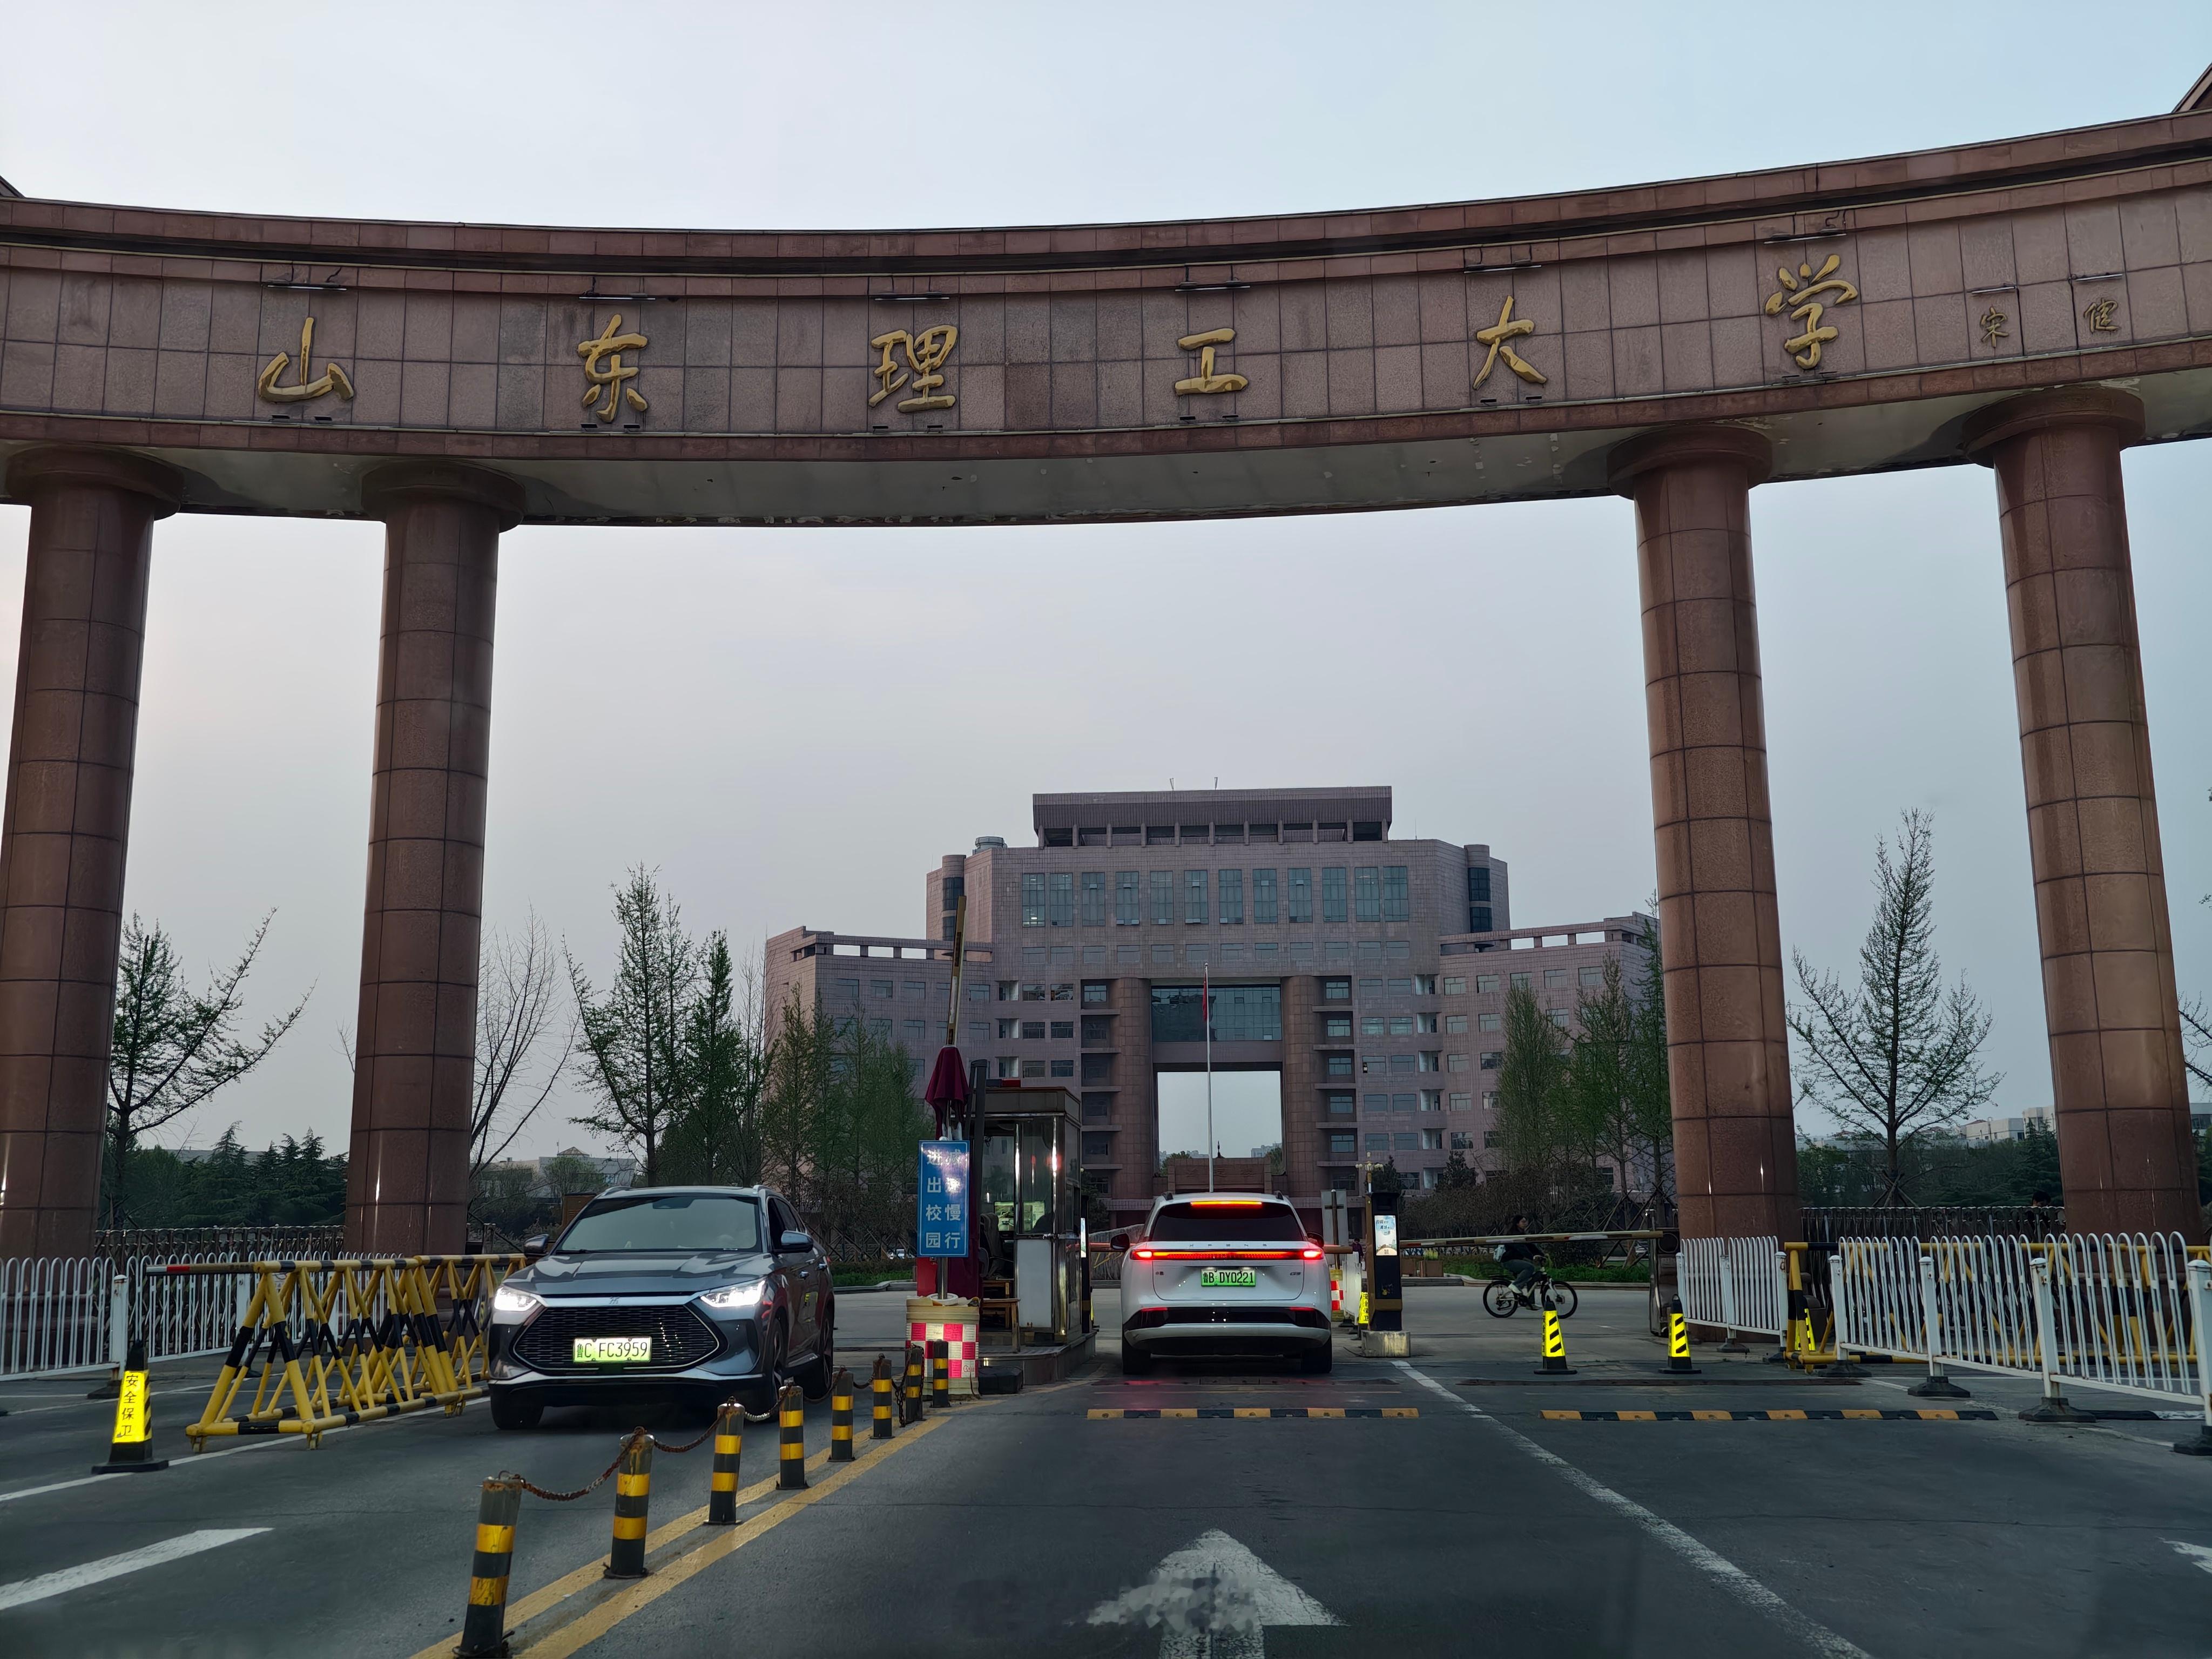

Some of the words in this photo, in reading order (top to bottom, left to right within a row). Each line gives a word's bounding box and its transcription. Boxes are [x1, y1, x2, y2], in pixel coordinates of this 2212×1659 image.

[257, 253, 1860, 424] 山东理工大学
[926, 1149, 943, 1249] 进出校园
[117, 1374, 138, 1438] 安全保卫
